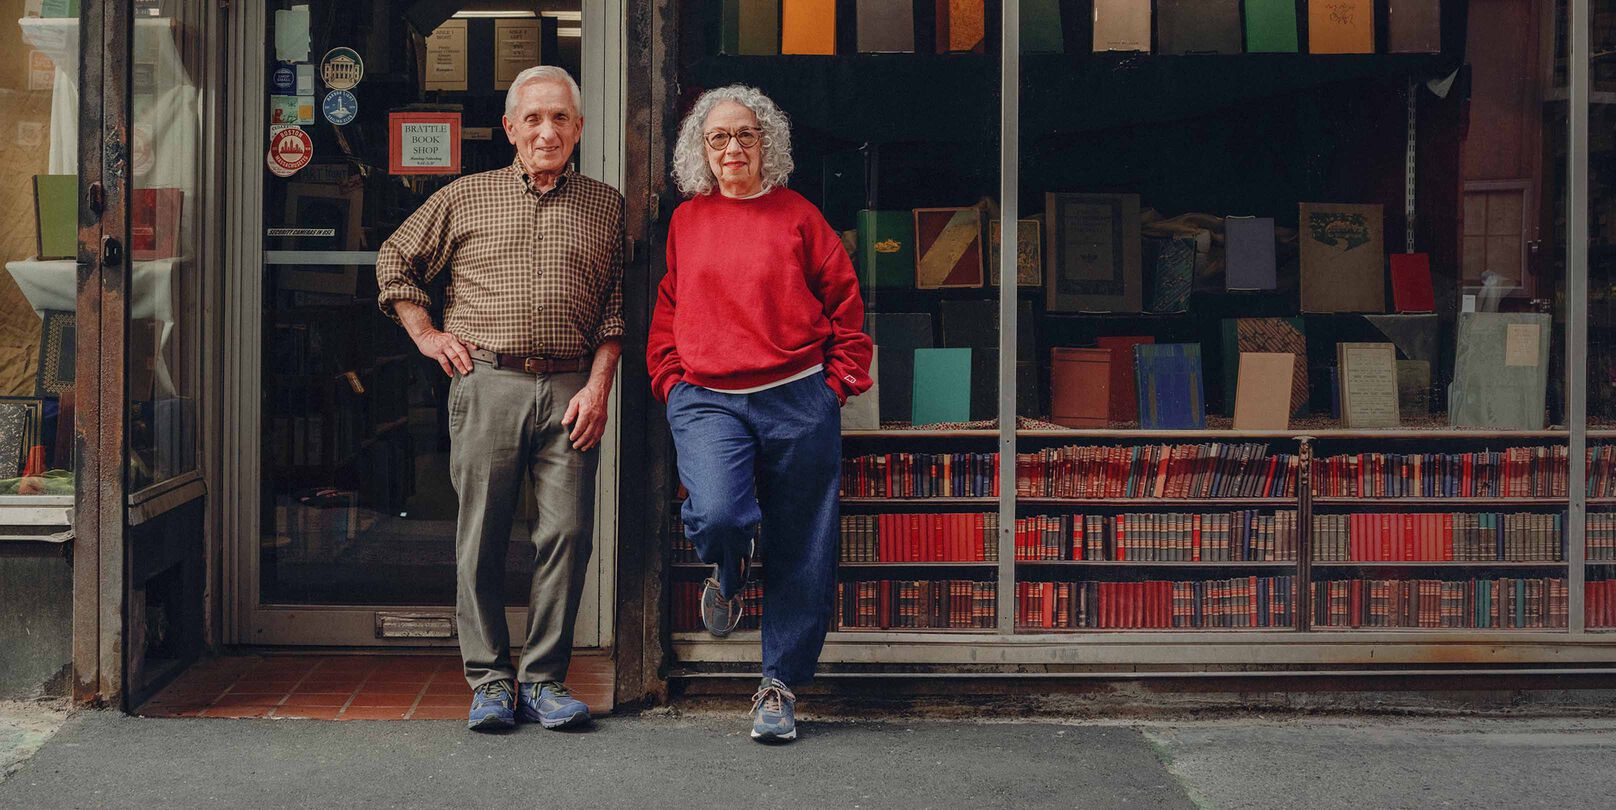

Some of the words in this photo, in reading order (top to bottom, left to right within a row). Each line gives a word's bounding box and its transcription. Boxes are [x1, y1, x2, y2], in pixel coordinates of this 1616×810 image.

[405, 125, 447, 133] BRATTLE
[280, 129, 304, 138] BOSTON
[412, 136, 440, 144] BOOK
[413, 146, 439, 154] SHOP
[275, 154, 309, 169] MASSACHUSETTS
